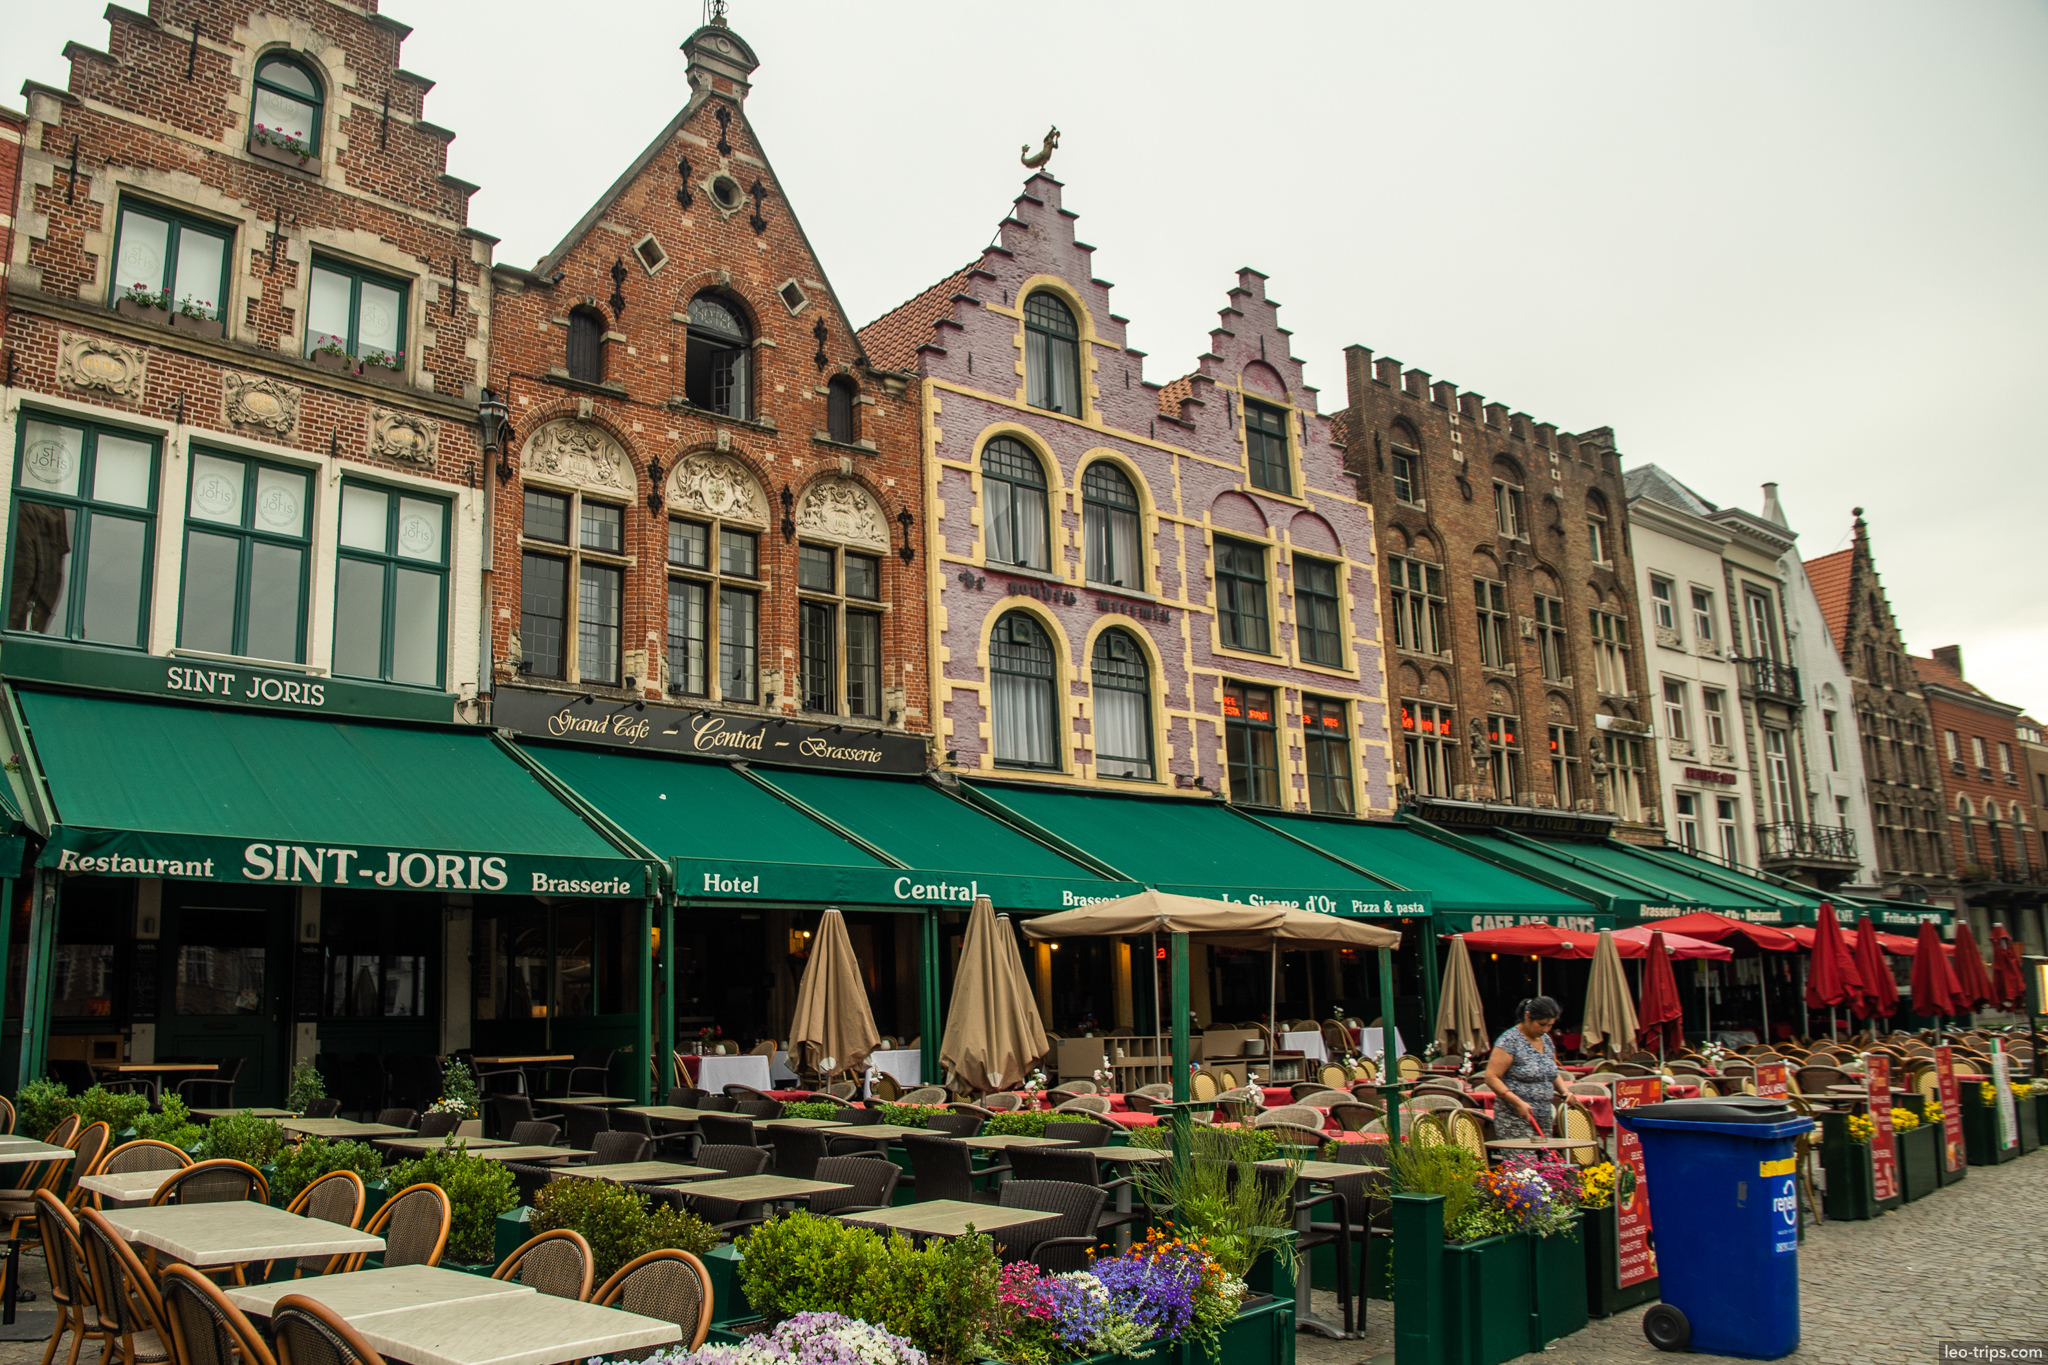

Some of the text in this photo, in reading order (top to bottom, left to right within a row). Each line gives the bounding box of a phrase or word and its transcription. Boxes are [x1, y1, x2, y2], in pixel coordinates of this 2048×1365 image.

[167, 666, 325, 707] SINT JORIS
[547, 708, 611, 736] Grand
[691, 714, 767, 751] Central
[799, 736, 883, 763] Brasserie
[1423, 807, 1507, 826] RESTAURANT
[57, 844, 631, 894] Restaurant SINT-JORIS Brasserie
[703, 873, 759, 894] Hotel
[894, 876, 977, 902] Central
[1305, 895, 1337, 913] d'Or
[1351, 899, 1380, 913] Pizza
[1383, 900, 1394, 914] &
[1396, 902, 1425, 916] pasta
[1640, 903, 1681, 918] Brasserie
[1630, 1150, 1643, 1161] SELEC
